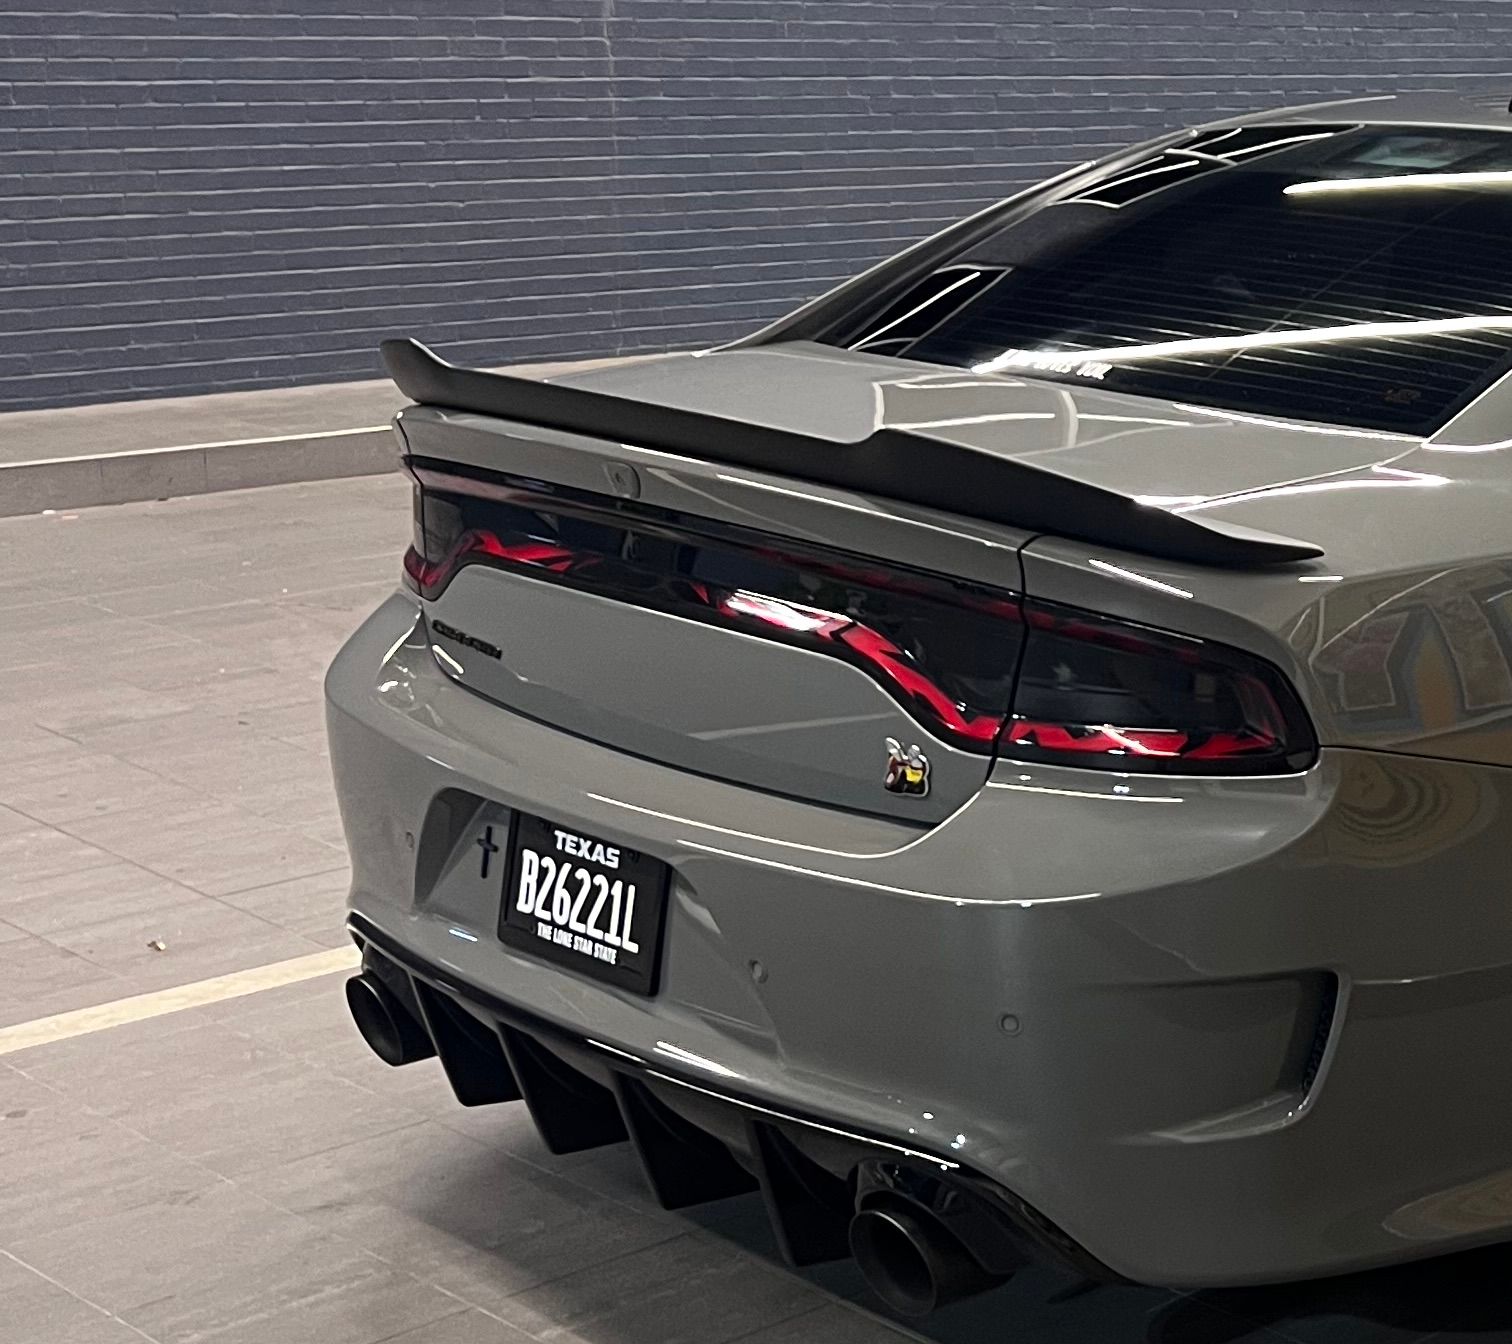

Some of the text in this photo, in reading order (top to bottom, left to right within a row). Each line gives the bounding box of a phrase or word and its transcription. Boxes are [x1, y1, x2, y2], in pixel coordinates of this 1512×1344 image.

[554, 830, 620, 869] TEXAS
[516, 849, 639, 954] B26221L
[537, 922, 552, 941] THE
[553, 927, 573, 948] LONE
[594, 943, 617, 965] STATE
